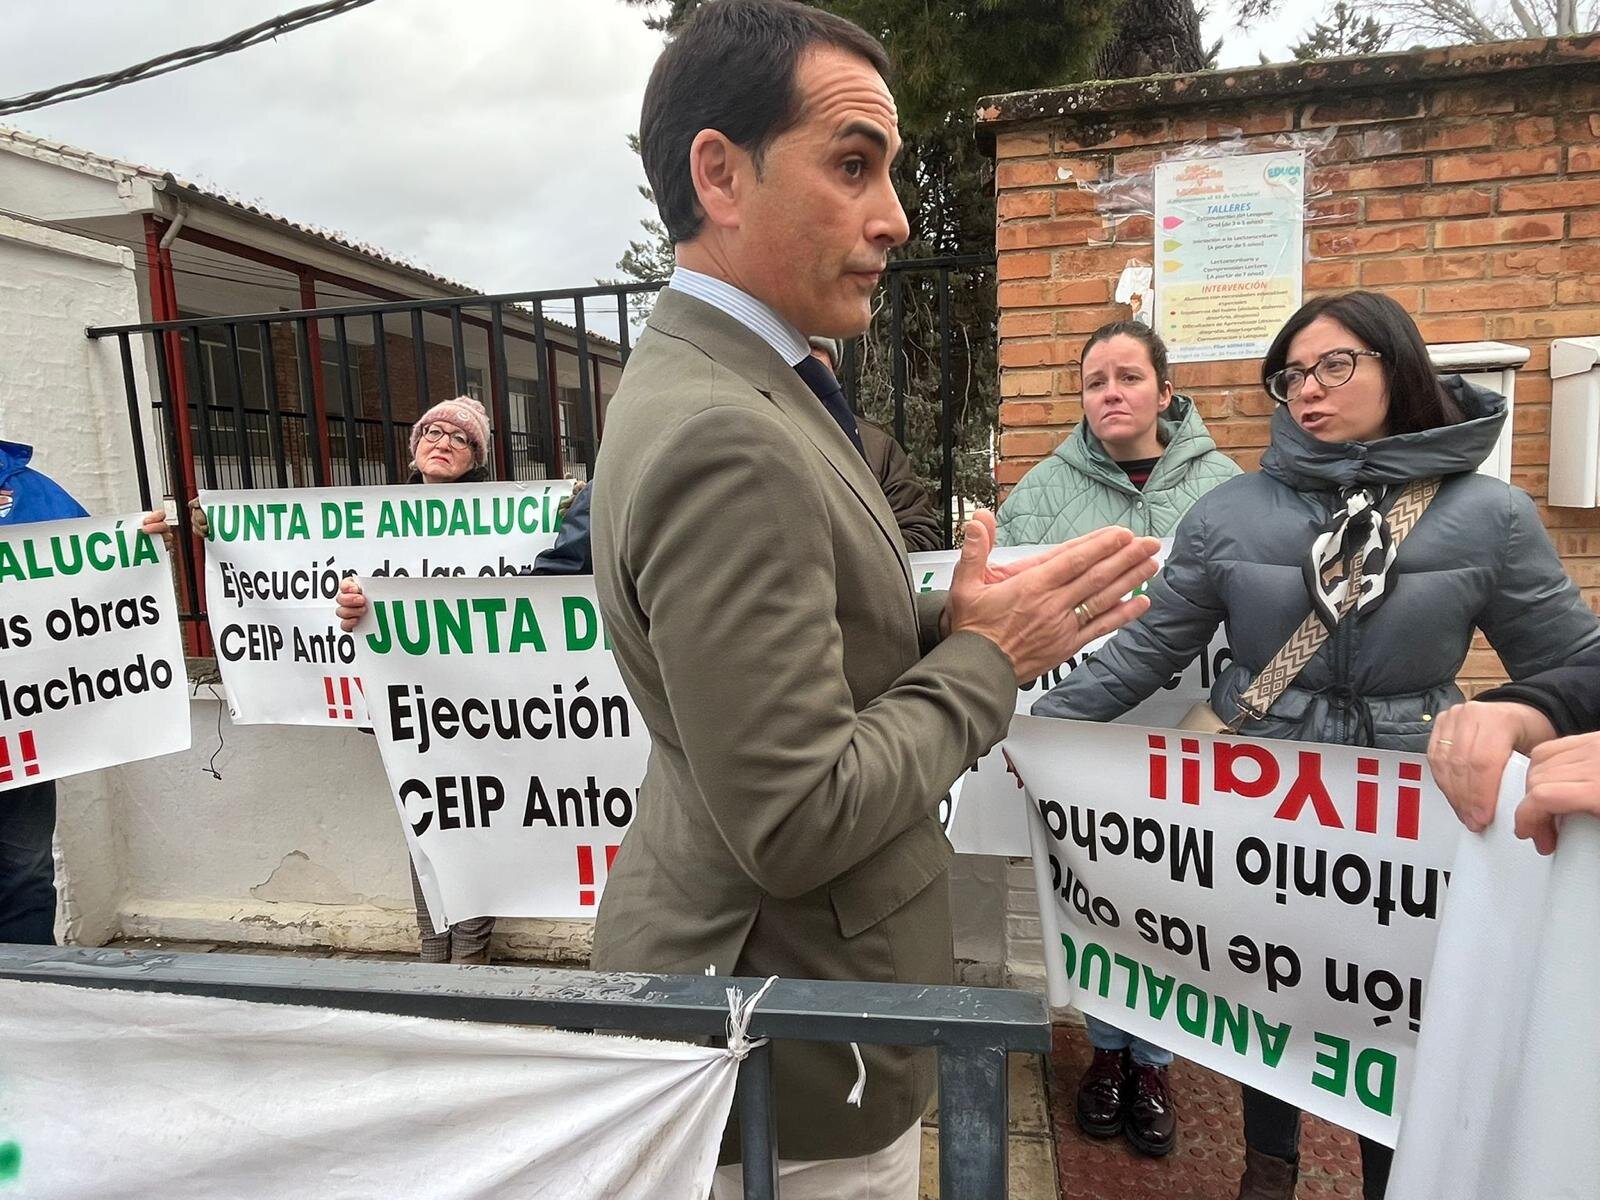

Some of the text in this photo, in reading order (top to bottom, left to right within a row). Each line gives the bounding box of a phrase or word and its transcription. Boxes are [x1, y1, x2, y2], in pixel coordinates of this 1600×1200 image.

[1267, 167, 1300, 178] EDUCA
[1207, 202, 1251, 214] TALLERES
[1202, 281, 1268, 294] INTERVENCIÓN
[207, 502, 310, 543] JUNTA
[321, 501, 365, 540] DE
[46, 594, 160, 641] obras
[220, 624, 356, 665] CEIP Anto
[366, 596, 613, 657] JUNTA D
[0, 654, 173, 721] achado
[388, 676, 630, 754] Ejecución
[399, 775, 640, 838] CEIP Anto
[1235, 835, 1451, 926] ntonio
[1134, 906, 1211, 972] las
[1228, 934, 1301, 992] de
[1325, 957, 1421, 1033] ión
[1311, 1031, 1398, 1117] DE
